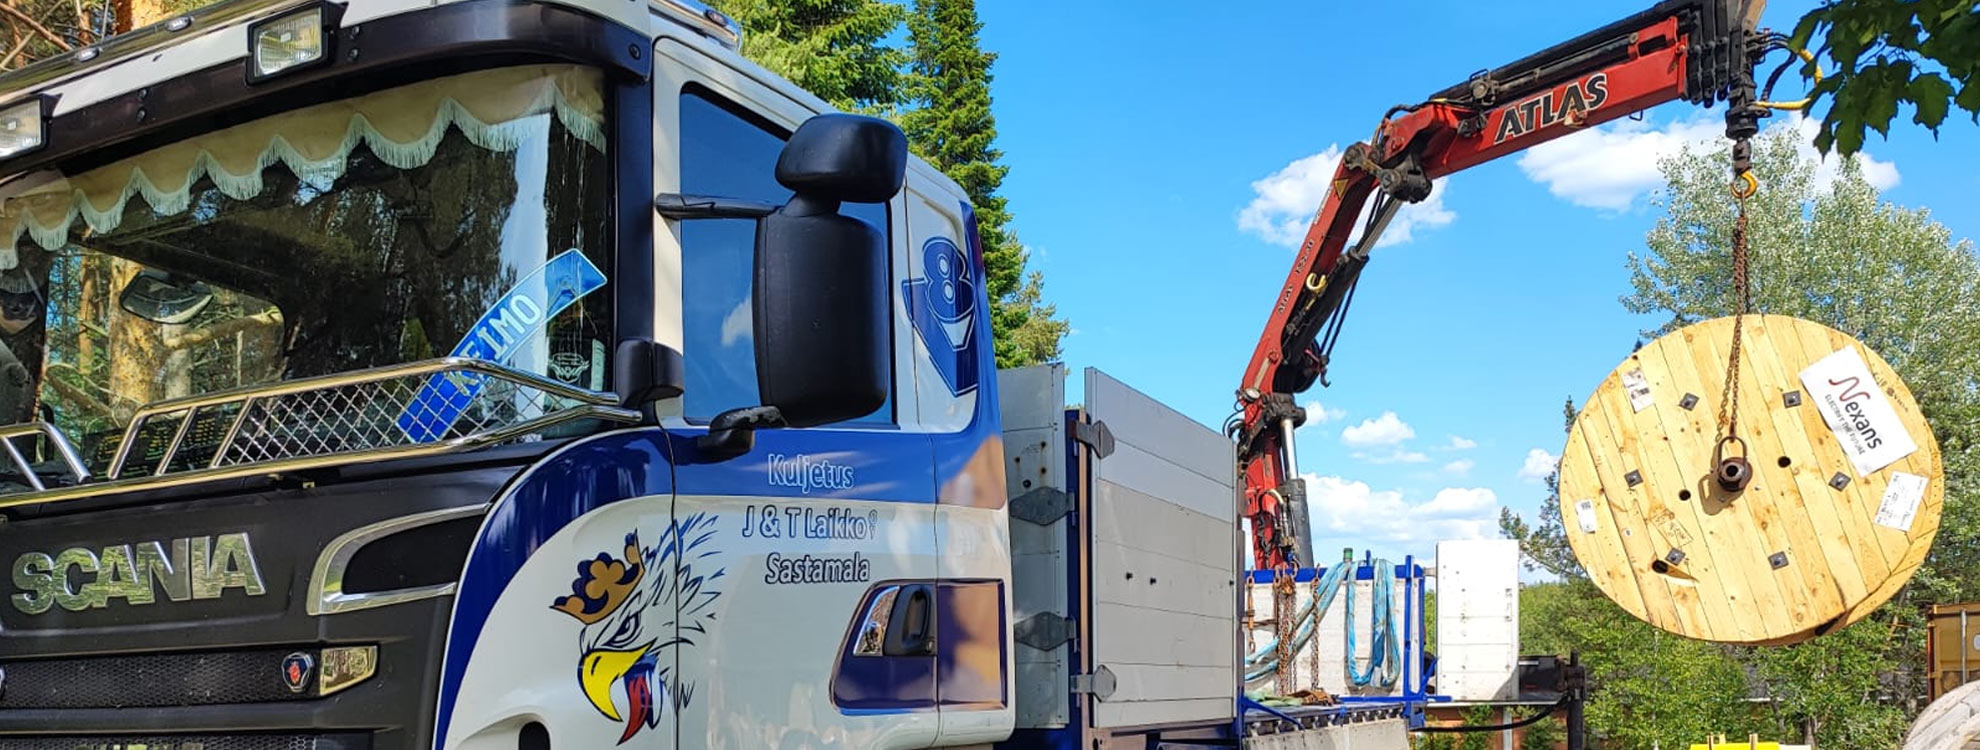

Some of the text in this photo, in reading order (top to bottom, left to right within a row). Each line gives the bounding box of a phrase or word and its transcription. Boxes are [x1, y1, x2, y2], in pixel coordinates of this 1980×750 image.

[1494, 73, 1608, 145] ATLAS
[1828, 376, 1882, 449] Nexans
[768, 453, 854, 494] Kuljetus
[742, 505, 755, 538] J
[760, 505, 780, 538] &
[785, 507, 801, 538] T
[805, 508, 867, 540] Laikko
[11, 532, 266, 615] SCANIA
[765, 551, 870, 584] Sastamala
